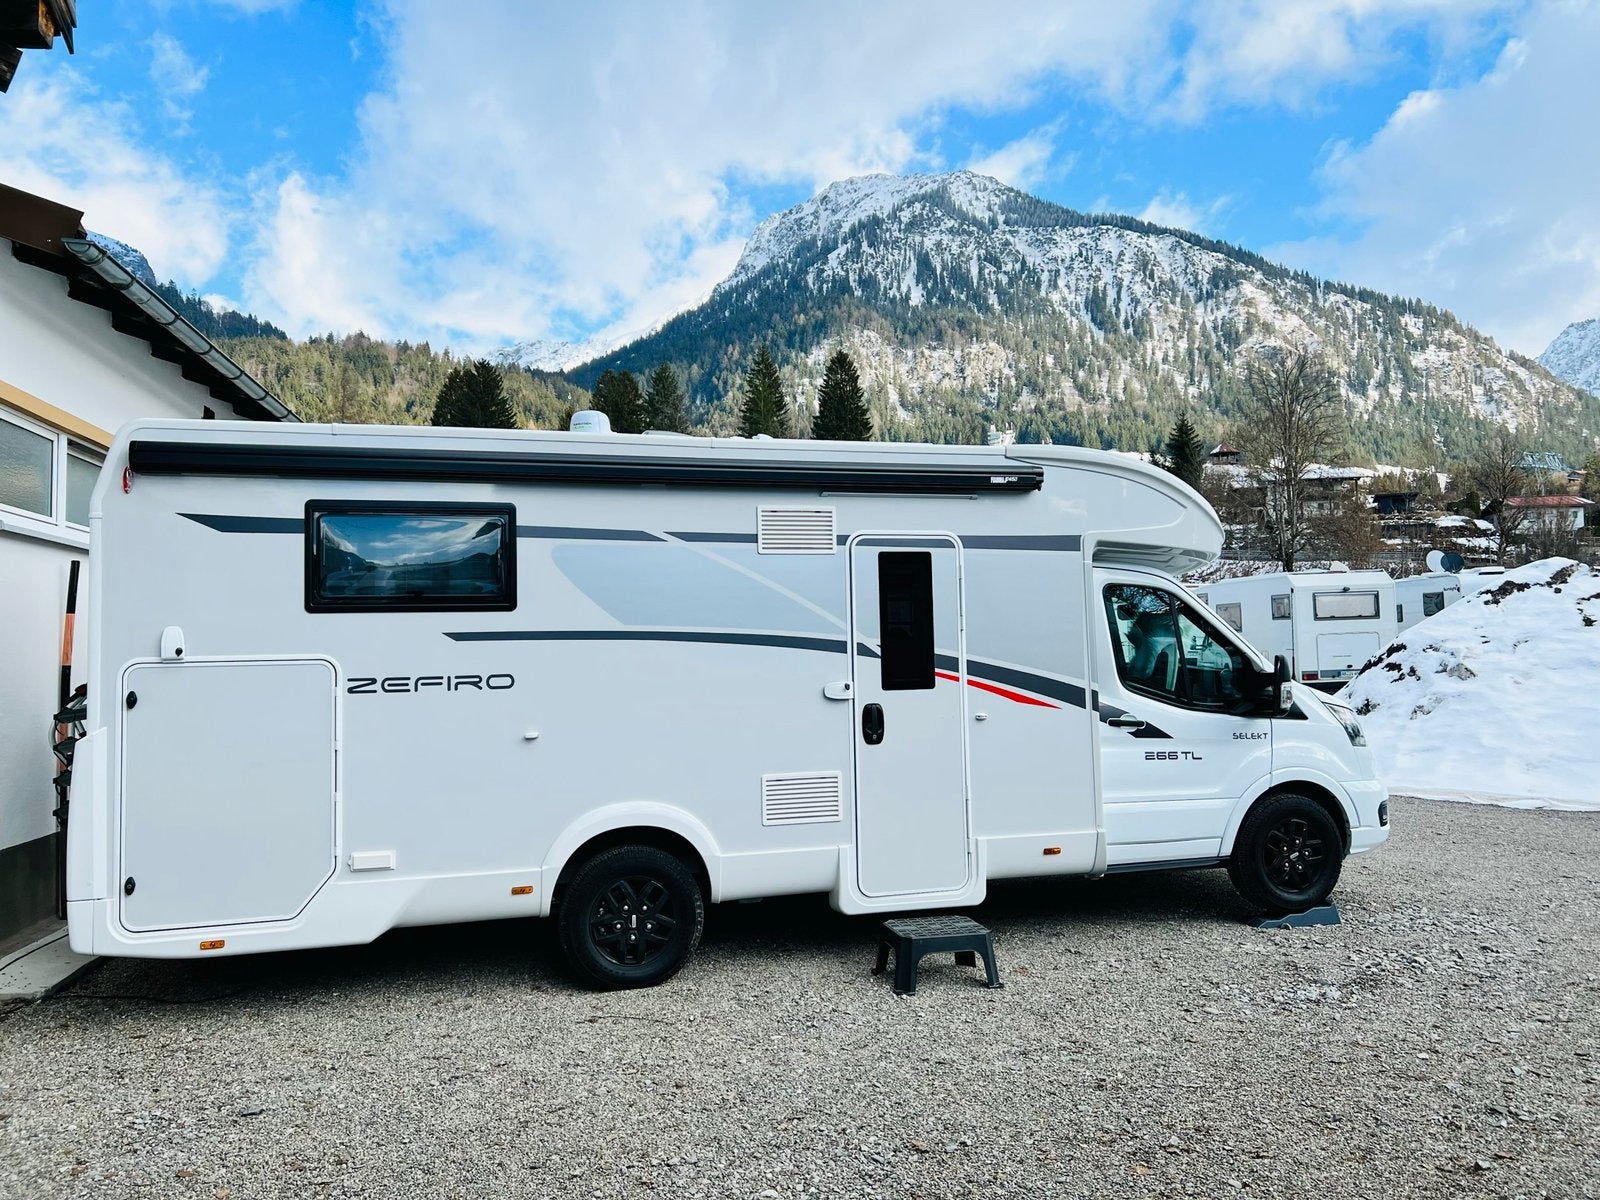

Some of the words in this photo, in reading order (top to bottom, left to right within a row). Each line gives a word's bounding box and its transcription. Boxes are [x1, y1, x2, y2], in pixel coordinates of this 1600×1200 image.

[347, 673, 516, 694] ZEFIRO
[1144, 751, 1179, 761] 266
[1180, 751, 1203, 761] TL
